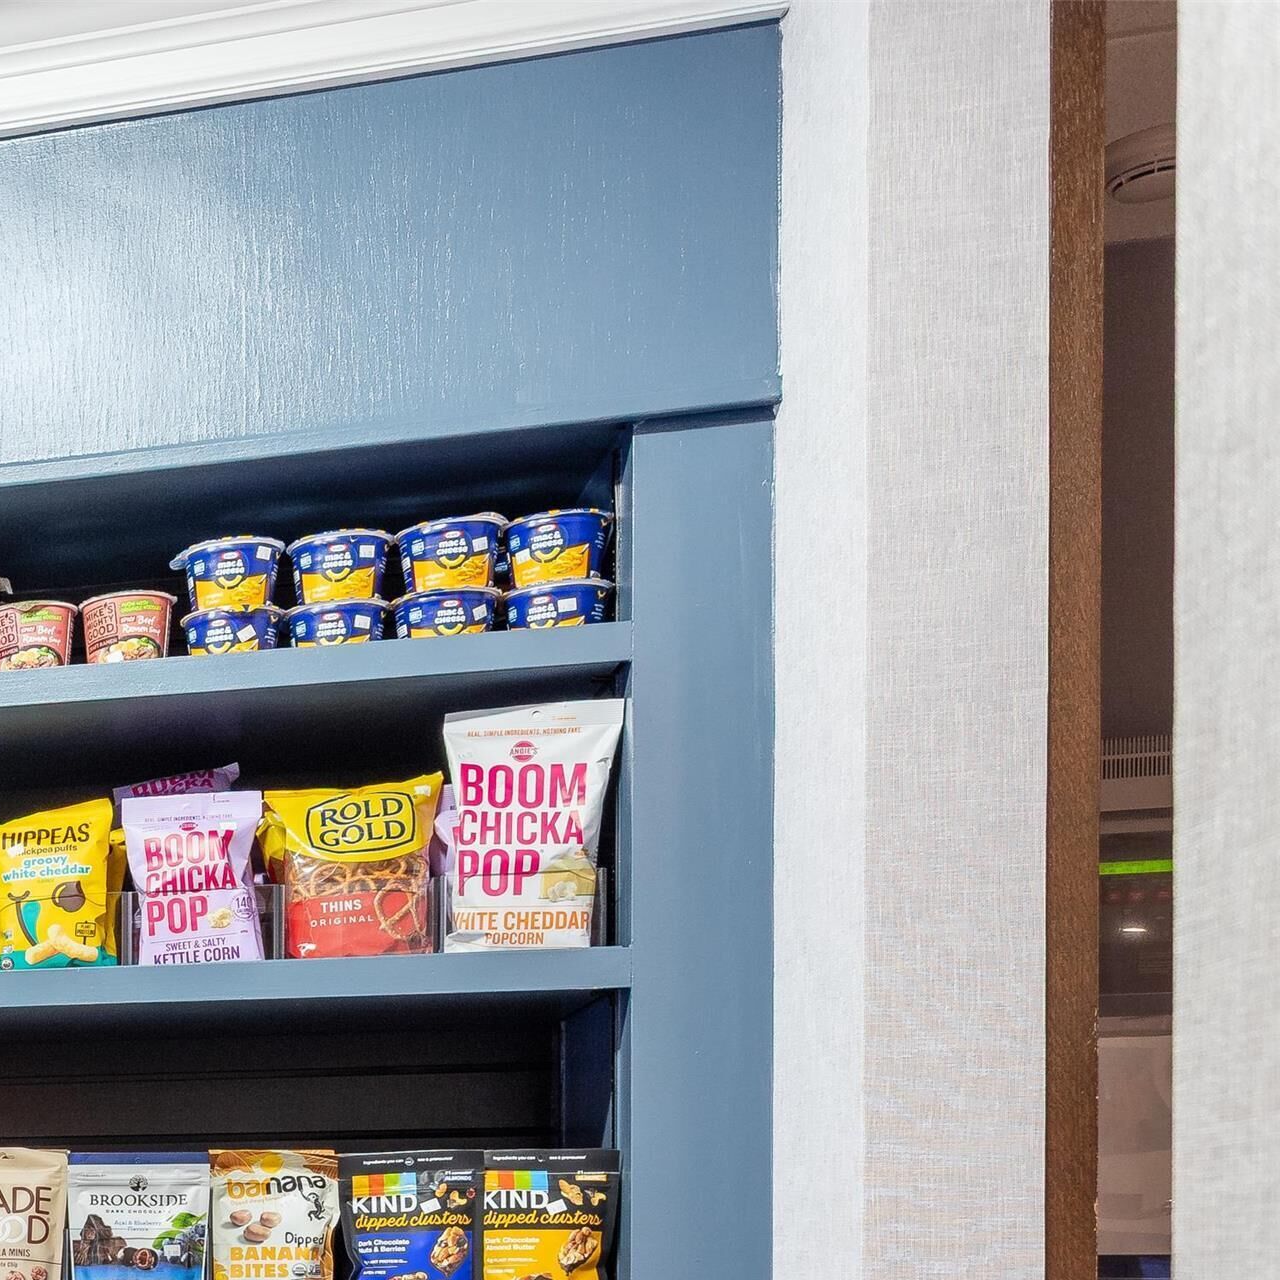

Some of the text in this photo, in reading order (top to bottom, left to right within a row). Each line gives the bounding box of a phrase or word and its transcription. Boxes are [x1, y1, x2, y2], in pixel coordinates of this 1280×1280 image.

[86, 605, 114, 622] MIKE'S
[88, 624, 114, 640] GOOD
[510, 748, 538, 756] ANGIE'S
[460, 763, 588, 809] BOOM
[320, 798, 404, 827] ROLD
[2, 822, 90, 850] HIPPEAS
[319, 819, 406, 848] GOLD
[458, 810, 584, 846] CHICKA
[54, 844, 78, 853] puffs
[144, 829, 234, 872] BOOM
[23, 854, 68, 868] groovy
[2, 864, 91, 882] white cheddar
[146, 862, 237, 898] CHICKA
[458, 849, 540, 897] POP
[148, 894, 208, 937] POP
[320, 899, 362, 914] THINS
[310, 915, 374, 927] ORIGINAL
[503, 911, 589, 931] CHEDDAR
[166, 938, 226, 952] SWEET SALTY
[486, 932, 544, 945] POPCORN
[154, 946, 240, 965] KETTLE CORN
[227, 1175, 326, 1199] barnana
[90, 1194, 187, 1208] BROOKSIDE
[352, 1195, 417, 1214] KIND
[484, 1190, 549, 1210] KIND
[356, 1211, 472, 1231] dipped clusters
[484, 1210, 538, 1228] dipped
[285, 1232, 324, 1248] Dipped
[9, 1248, 30, 1258] MINIS
[230, 1263, 289, 1278] BITES
